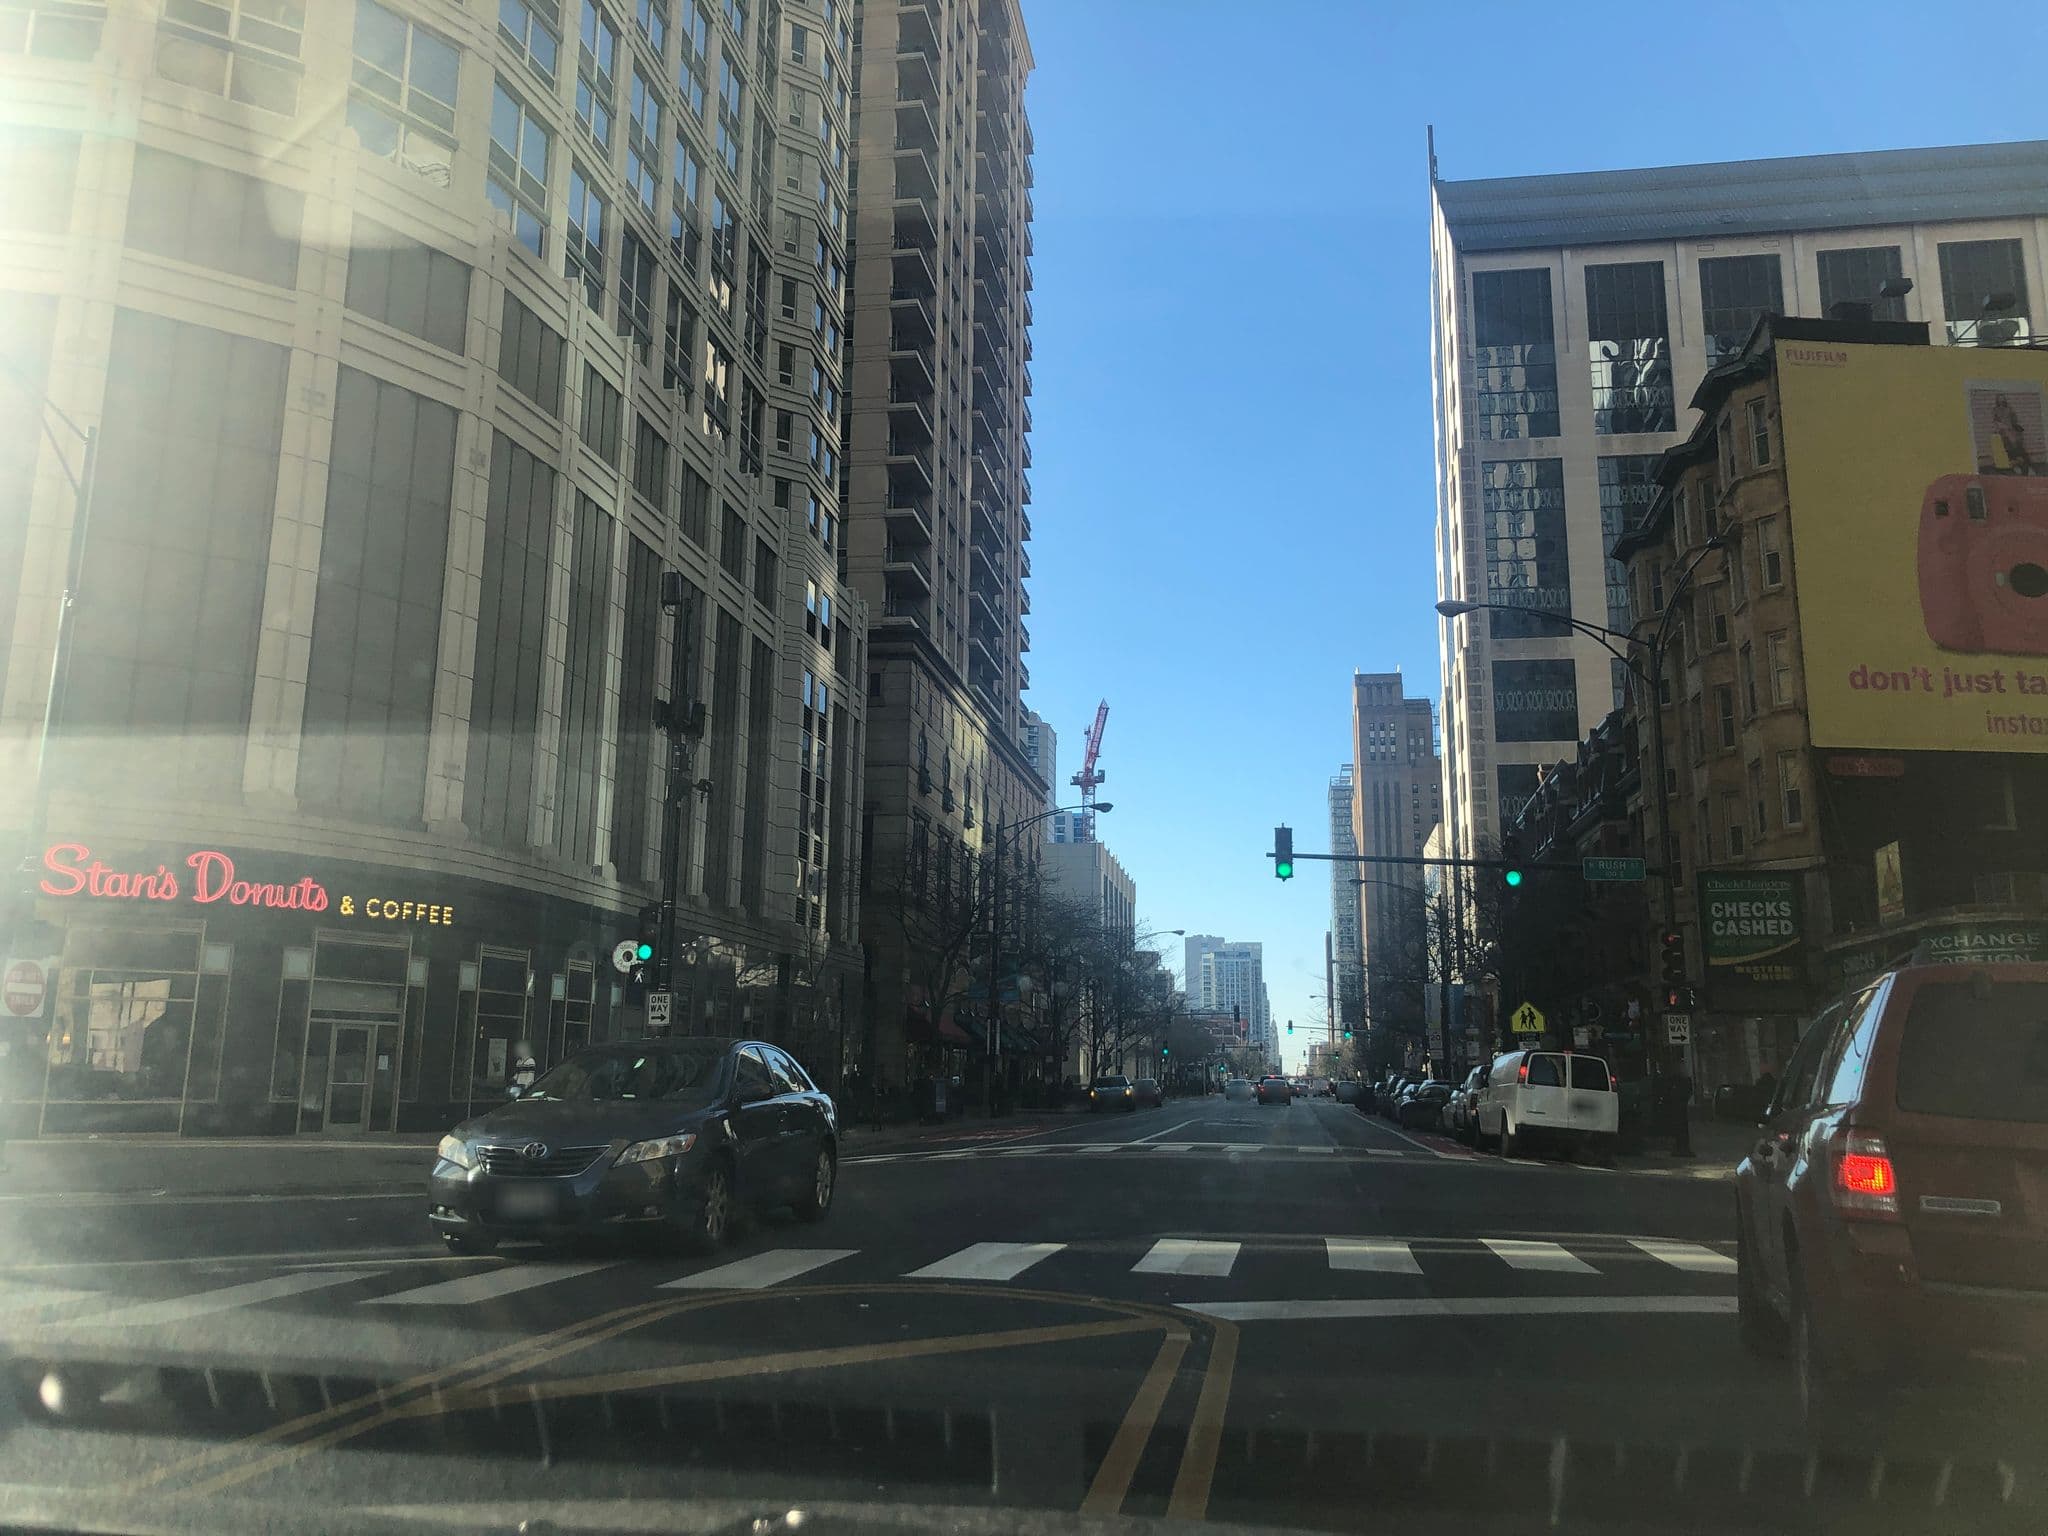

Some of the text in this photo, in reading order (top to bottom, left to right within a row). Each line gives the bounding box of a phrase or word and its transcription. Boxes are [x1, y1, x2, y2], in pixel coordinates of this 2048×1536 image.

[1786, 349, 1847, 362] FUJIFILM
[1849, 664, 1933, 692] don't
[1943, 667, 2006, 697] just
[1598, 860, 1627, 870] RUSH
[40, 843, 453, 925] Stan's Donuts & COFFEE
[1711, 901, 1792, 918] CHECKS
[1712, 919, 1793, 936] CASHED
[651, 995, 669, 1004] ONE
[651, 1004, 669, 1013] WAY
[1669, 1016, 1688, 1025] ONE
[1669, 1024, 1688, 1033] WAY
